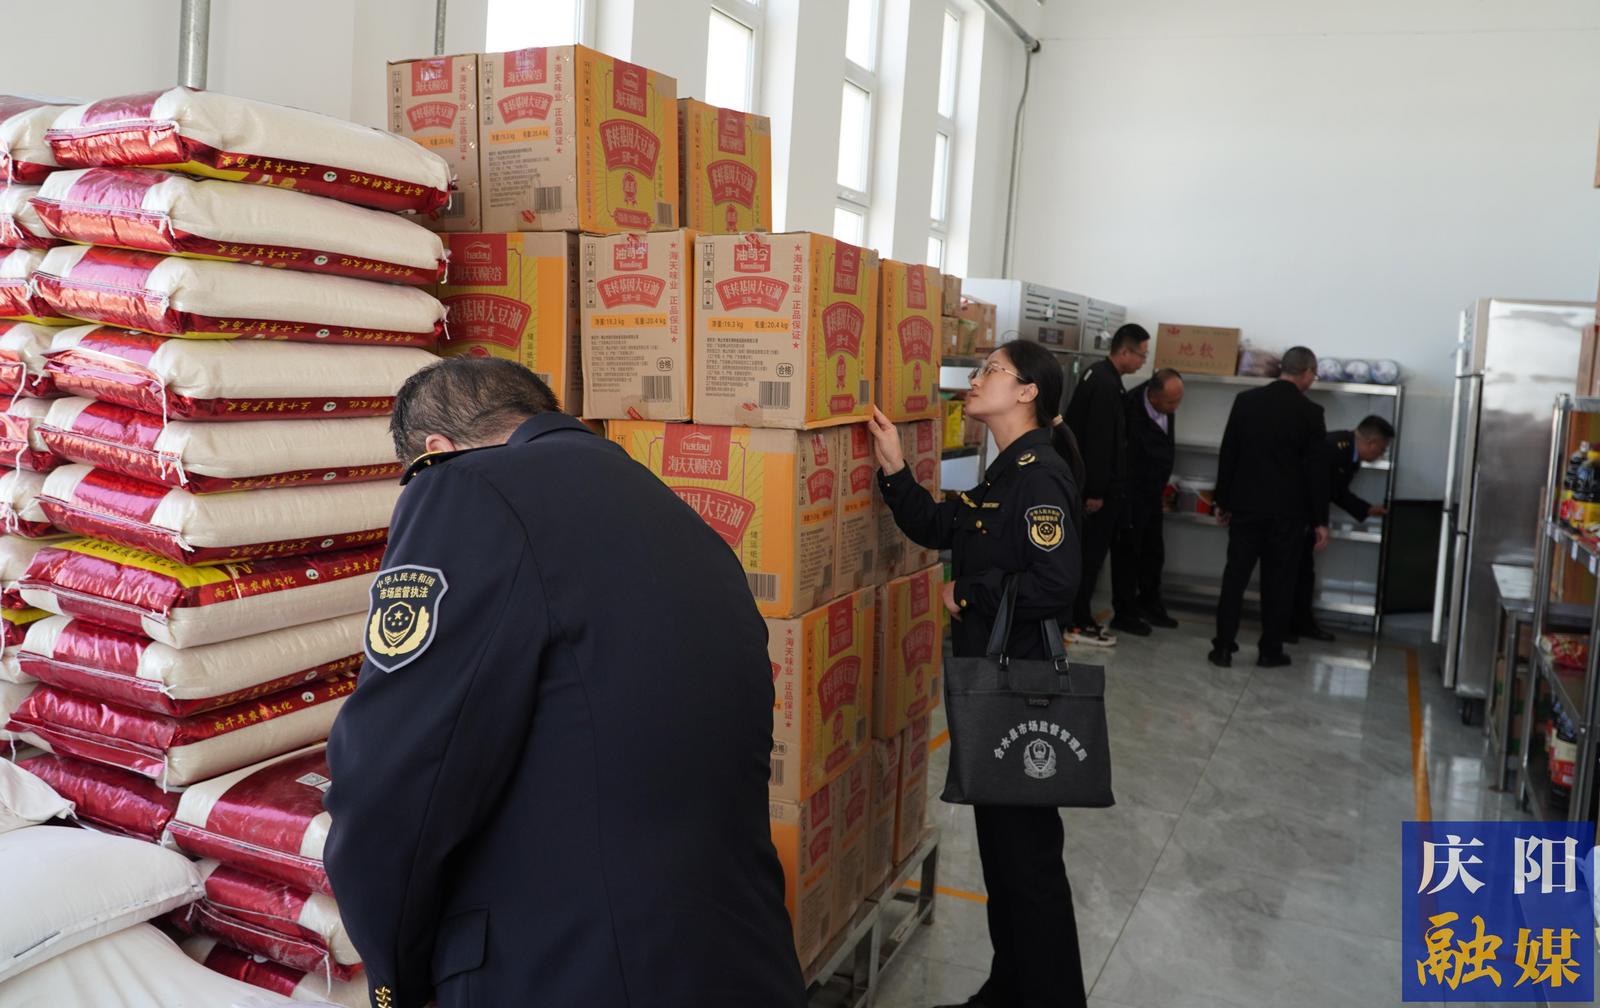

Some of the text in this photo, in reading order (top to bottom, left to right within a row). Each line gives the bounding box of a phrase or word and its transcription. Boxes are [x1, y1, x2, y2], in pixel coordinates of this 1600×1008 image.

[791, 254, 802, 340] 海天味业 正品保证
[683, 441, 710, 453] haday
[376, 572, 436, 589] 中华人民共和国
[379, 586, 429, 600] 市场监管执法
[994, 720, 1088, 762] 合水县市场监督管理局
